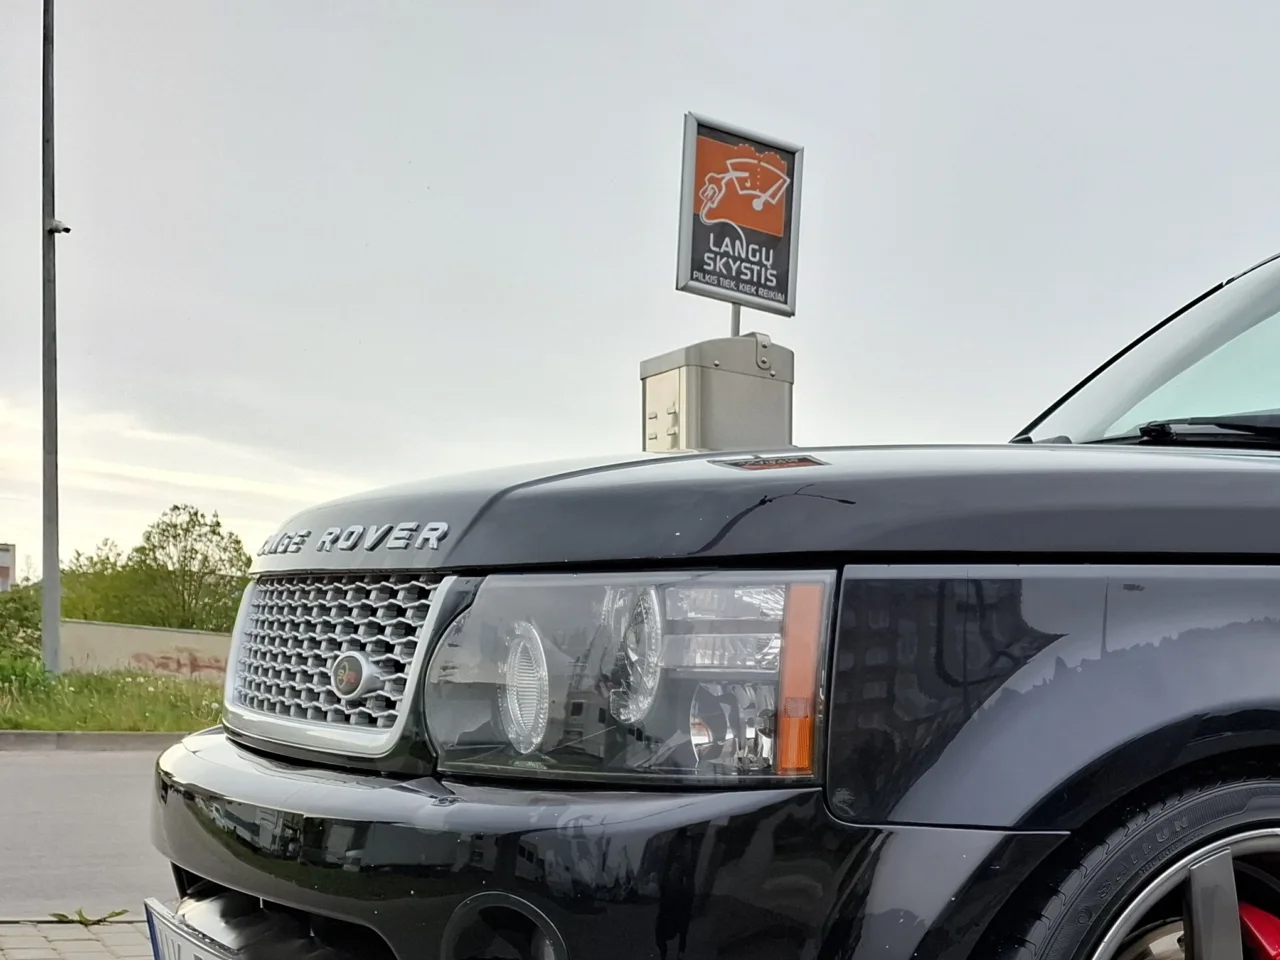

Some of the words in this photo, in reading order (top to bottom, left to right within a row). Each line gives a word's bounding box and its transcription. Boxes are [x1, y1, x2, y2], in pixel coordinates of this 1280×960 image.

[708, 232, 774, 268] LANGŲ
[703, 252, 777, 287] SKYSTIS
[738, 282, 757, 295] KIEK
[316, 521, 449, 552] ROVER
